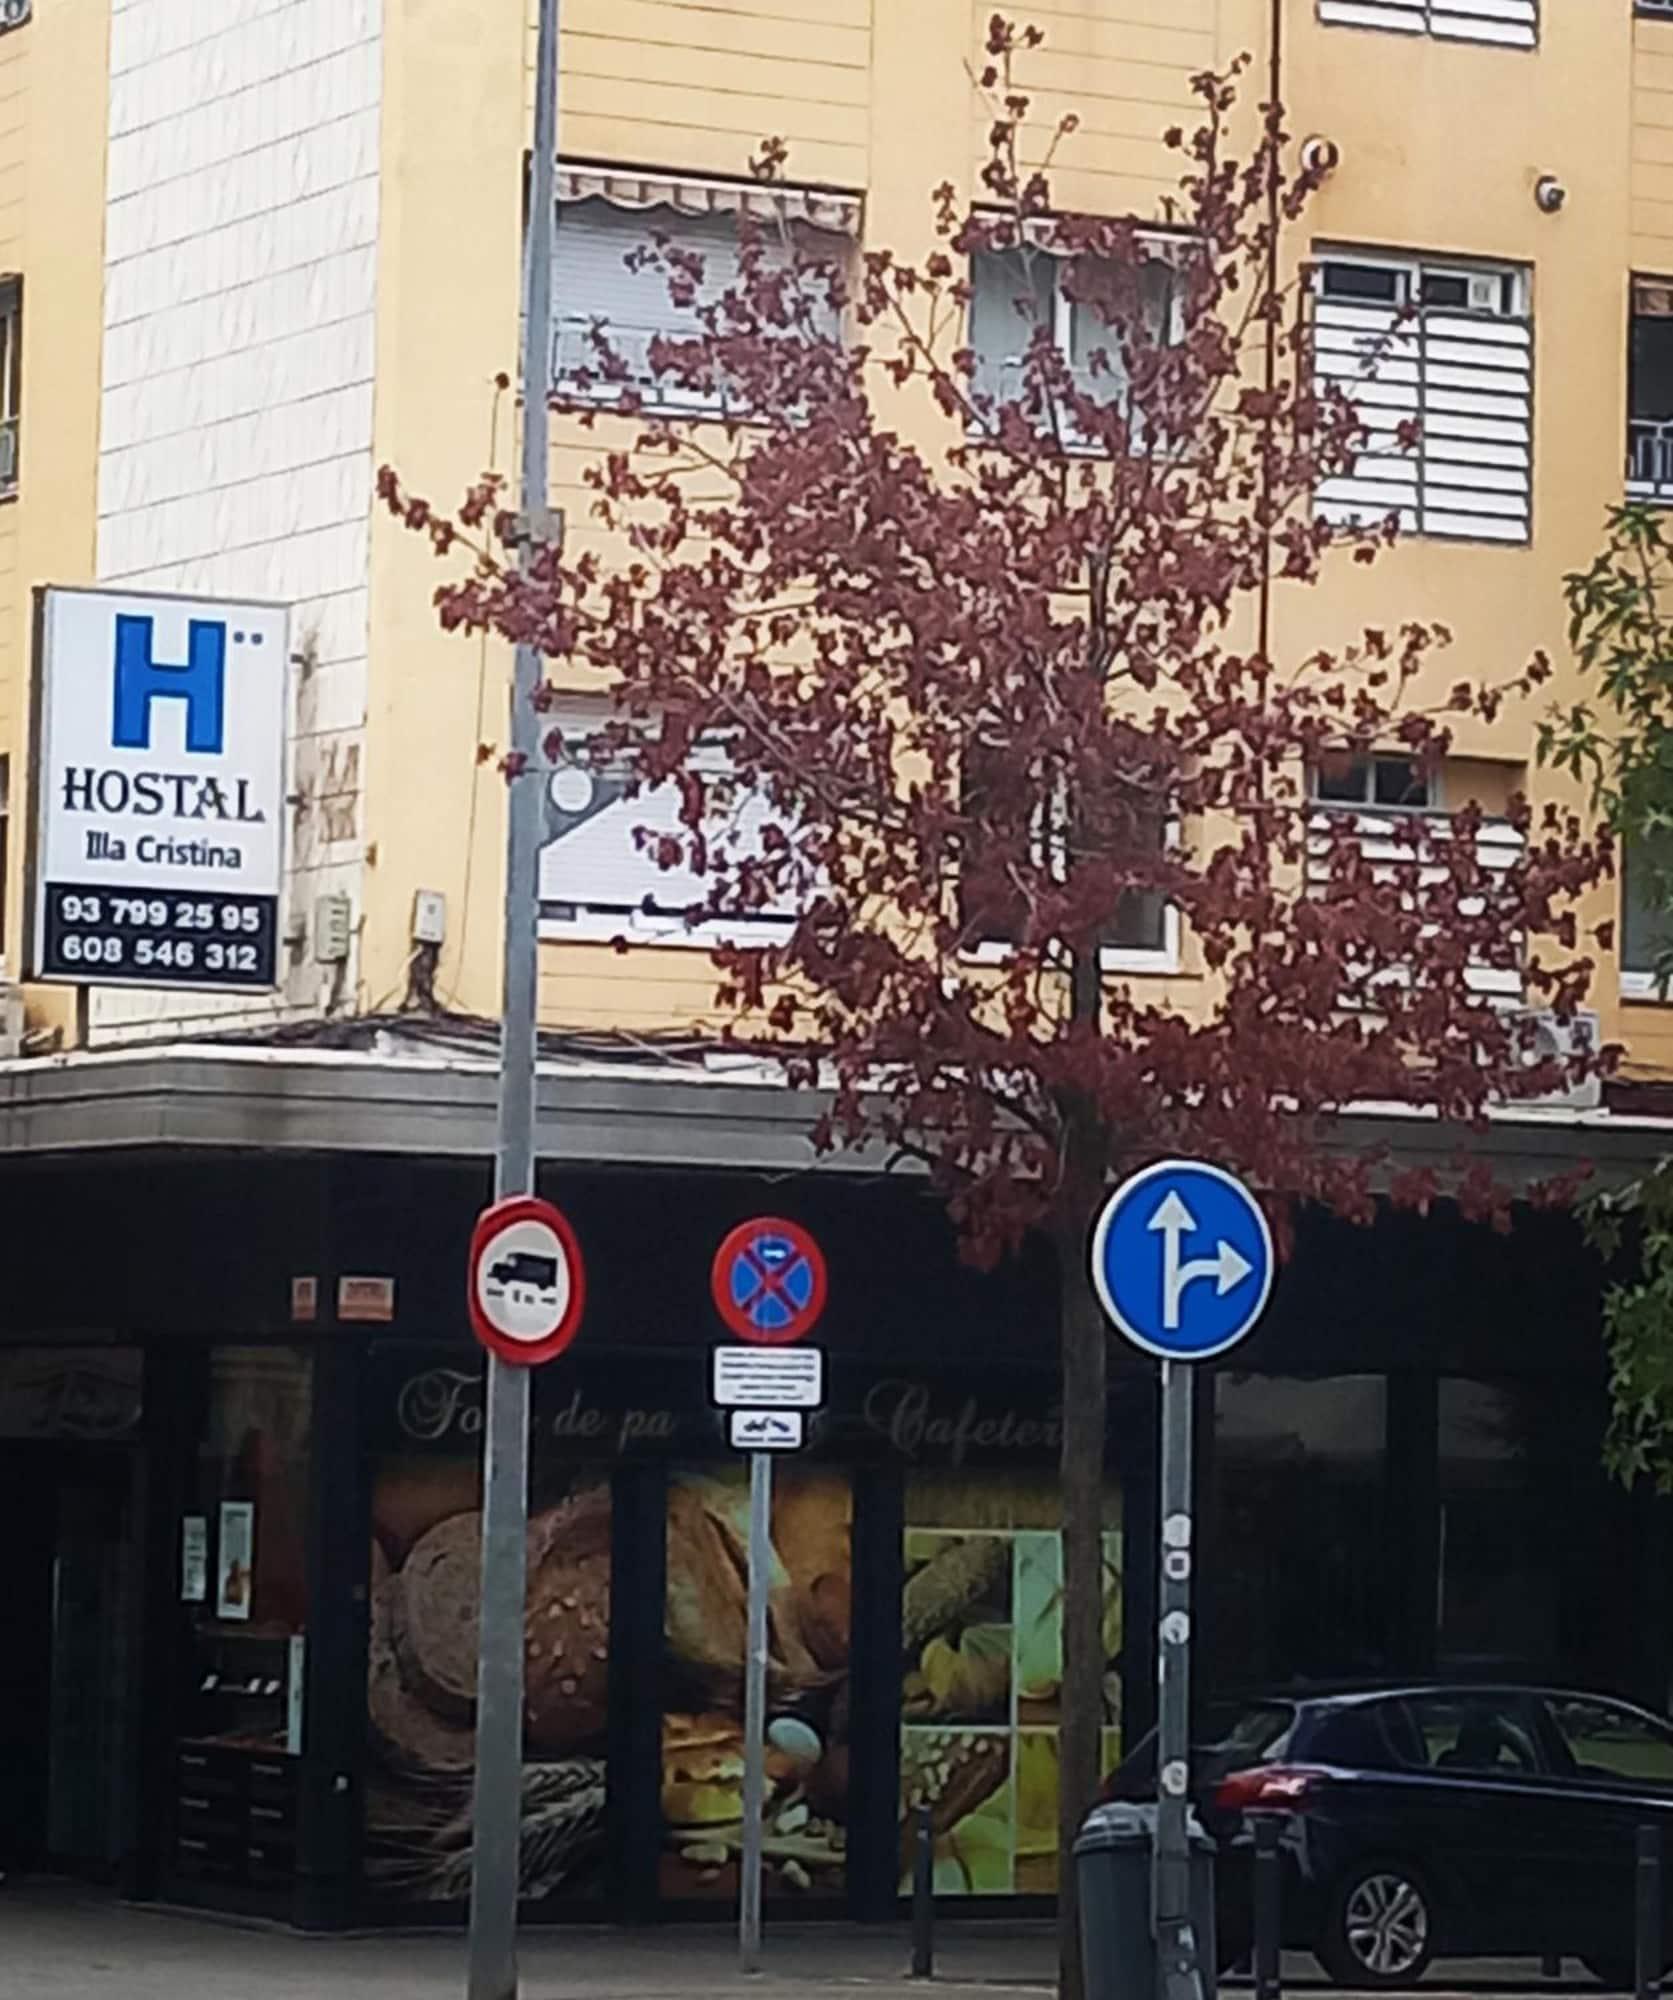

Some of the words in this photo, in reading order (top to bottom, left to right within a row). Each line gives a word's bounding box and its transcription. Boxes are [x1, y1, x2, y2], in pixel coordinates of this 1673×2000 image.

[112, 613, 226, 754] H
[62, 767, 265, 823] HOSTAL
[87, 830, 126, 861] Illa
[136, 834, 242, 869] Cristina
[61, 895, 100, 922] 93
[111, 898, 167, 926] 799
[175, 901, 214, 929] 25
[221, 904, 260, 932] 95
[62, 936, 122, 963] 608
[135, 940, 194, 967] 546
[205, 944, 257, 971] 312
[552, 1387, 606, 1436] de
[617, 1407, 676, 1456] pa
